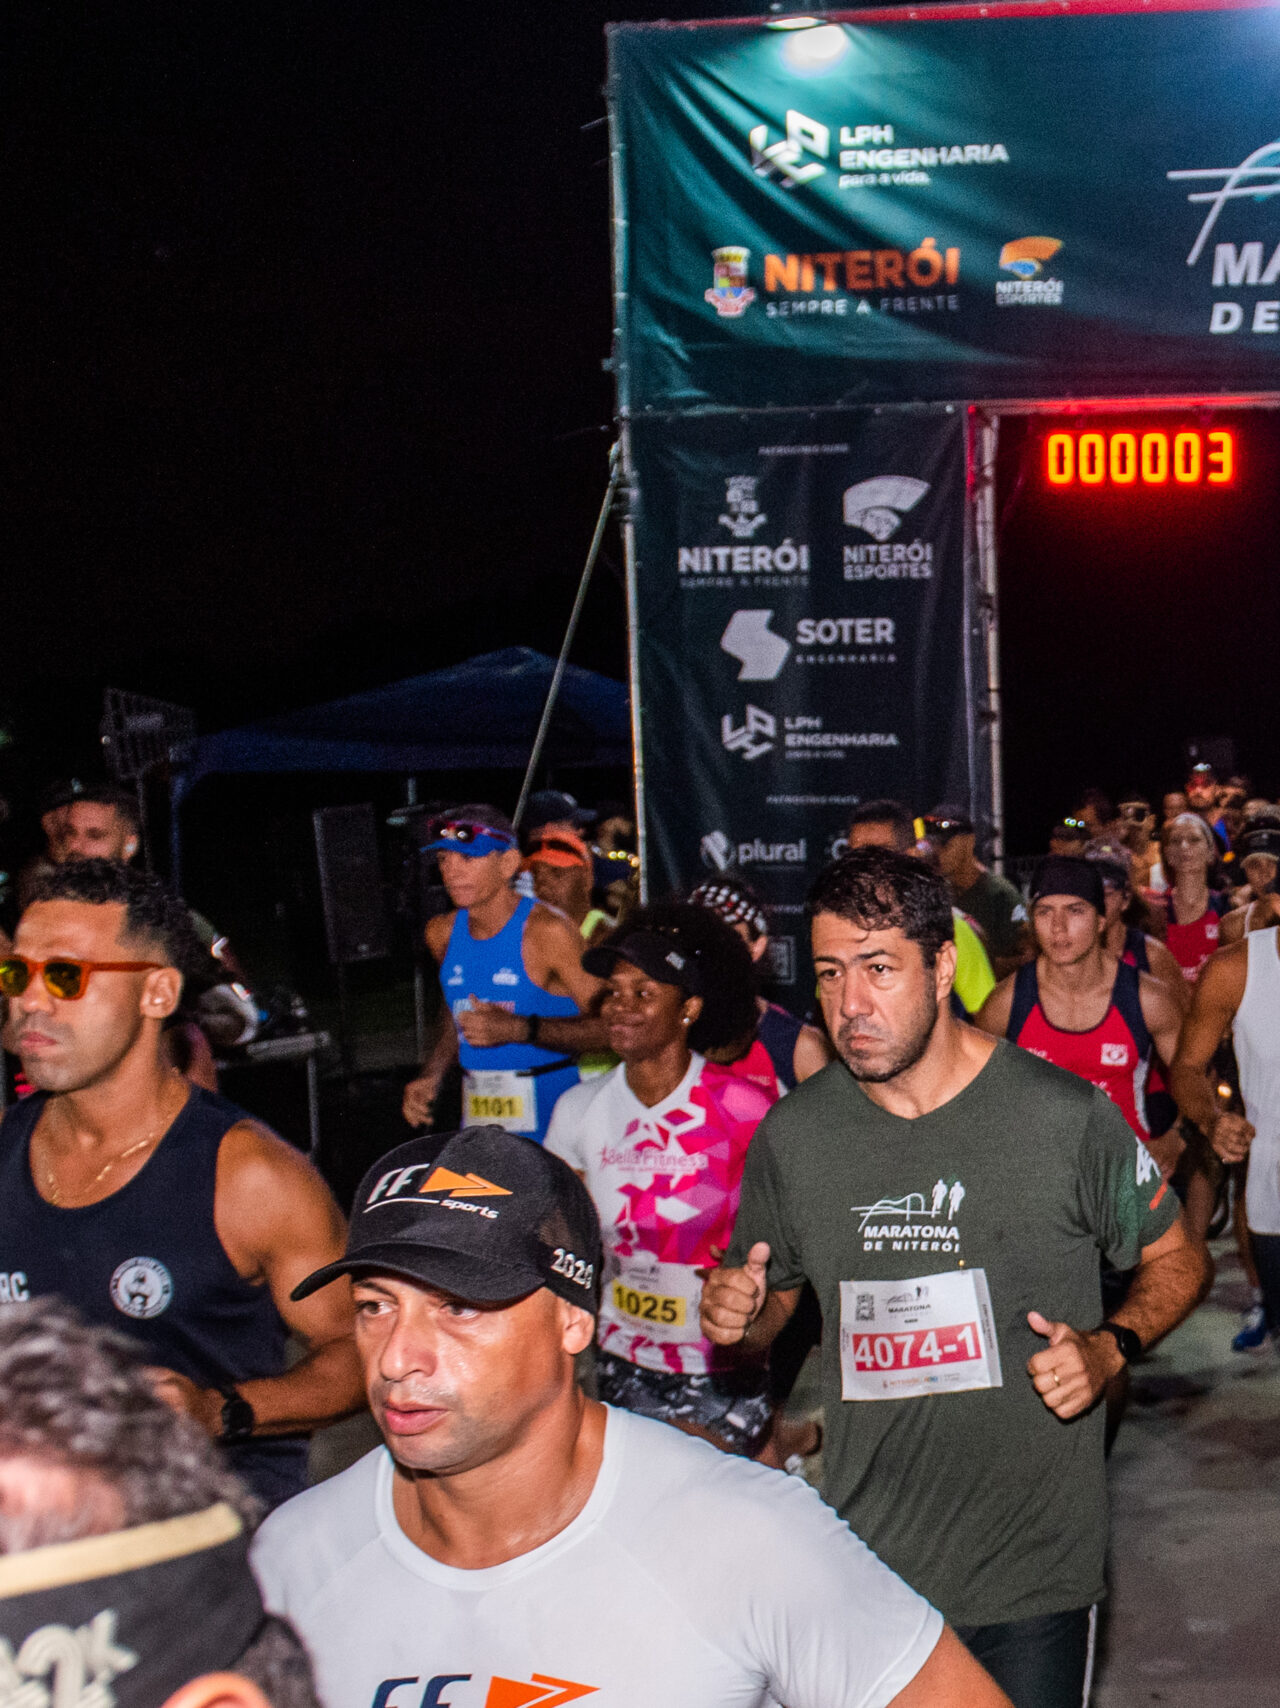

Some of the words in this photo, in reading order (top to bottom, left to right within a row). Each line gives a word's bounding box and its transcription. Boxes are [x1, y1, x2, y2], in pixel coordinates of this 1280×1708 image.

[840, 124, 894, 146] LPH
[839, 143, 1010, 170] ENGENHARIA
[839, 172, 877, 189] para
[879, 172, 891, 186] a
[764, 237, 961, 293] NITERÓI
[995, 277, 1065, 294] NITERÓI
[765, 299, 848, 319] SEMPRE
[879, 294, 960, 313] FRENTE
[1047, 431, 1234, 484] 000003
[678, 538, 810, 573] NITERÓI
[843, 539, 932, 563] NITERÓI
[843, 562, 932, 580] ESPORTES
[796, 617, 896, 645] SOTER
[784, 716, 823, 730] LPH
[785, 732, 899, 747] ENGENHARIA
[738, 837, 807, 866] plural
[440, 1199, 499, 1219] sports
[863, 1224, 960, 1240] MARATONA
[863, 1240, 883, 1251] DE
[892, 1238, 960, 1253] NITERÓI
[616, 1286, 677, 1323] 1025
[855, 1325, 976, 1369] 4074-1
